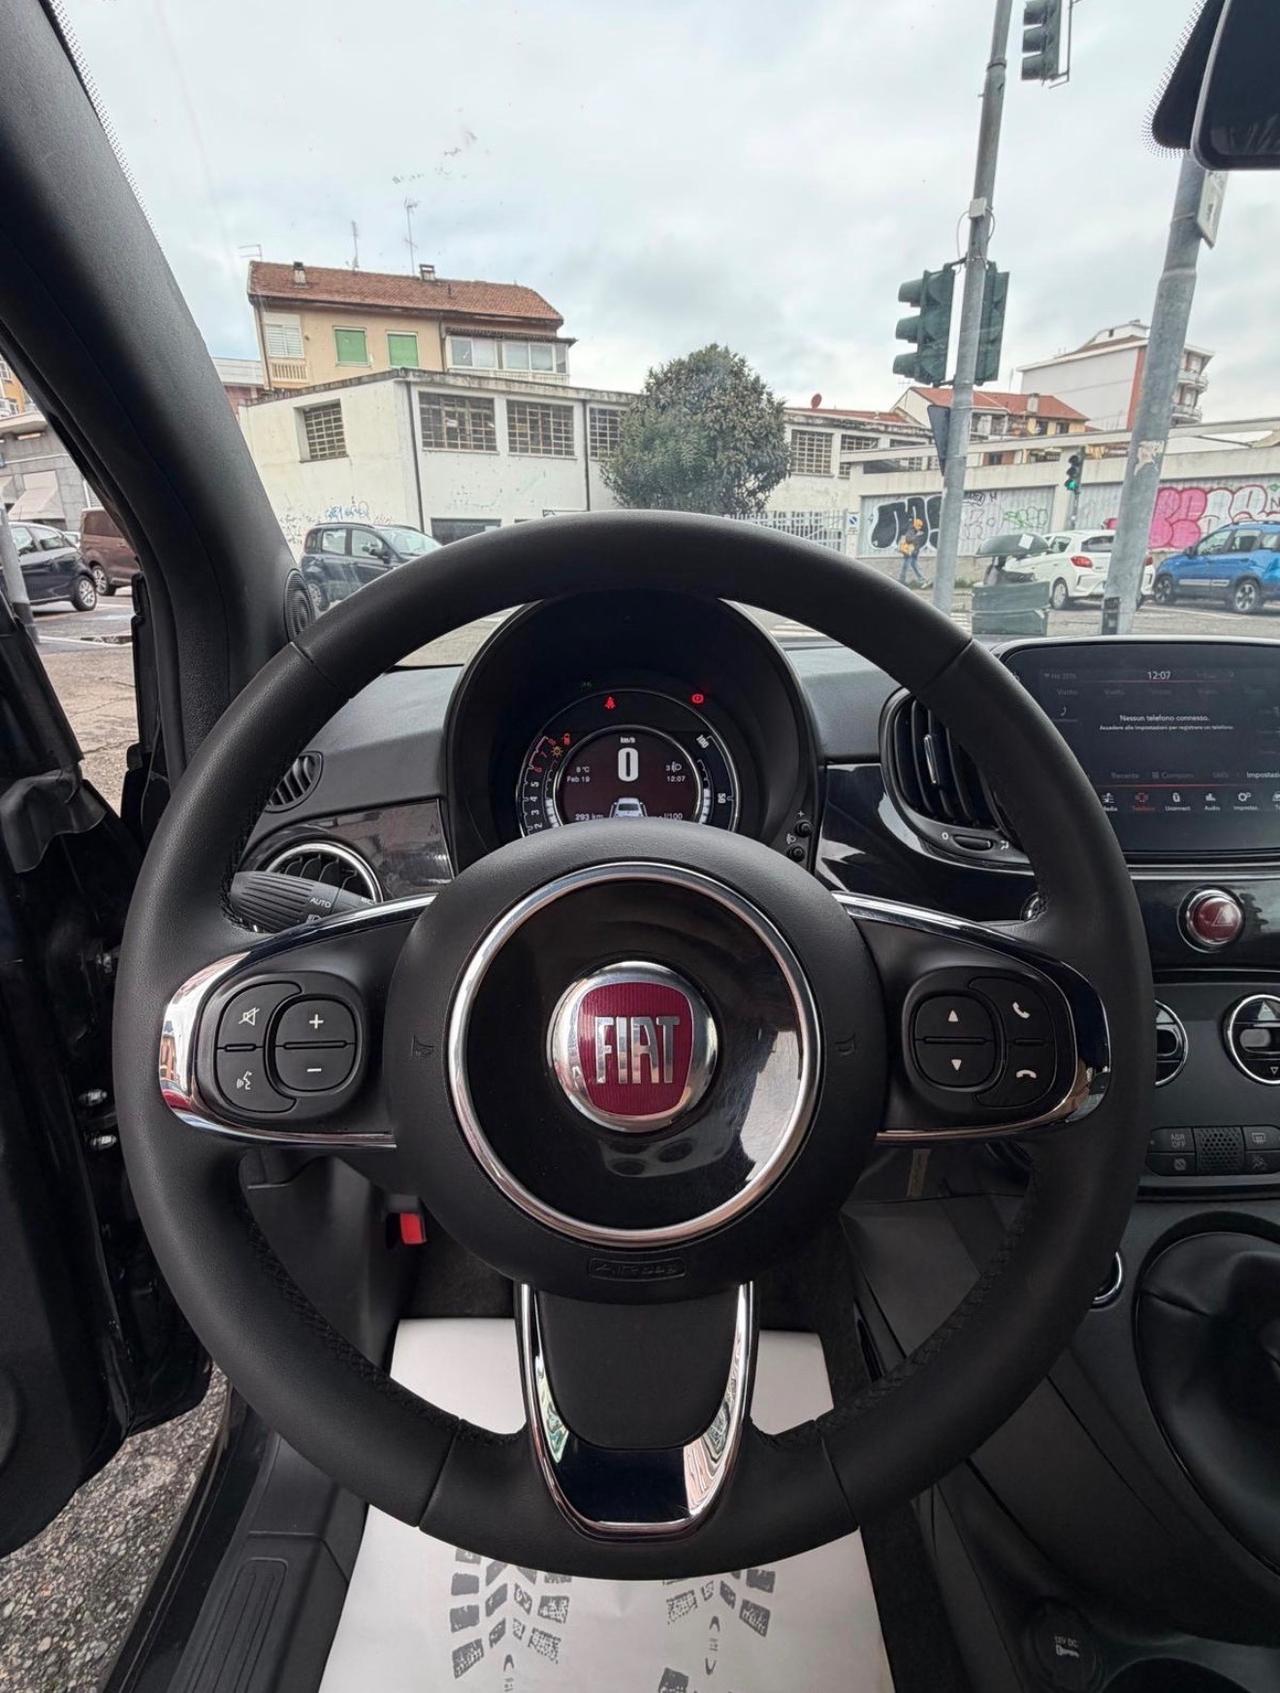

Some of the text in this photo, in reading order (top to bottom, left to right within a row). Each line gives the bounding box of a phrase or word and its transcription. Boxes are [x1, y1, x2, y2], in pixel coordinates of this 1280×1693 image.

[1147, 670, 1172, 681] 12:07
[1119, 714, 1145, 722] Nessun
[1146, 713, 1175, 722] telefono
[617, 747, 639, 782] 0
[566, 775, 580, 783] Feb
[309, 897, 332, 909] AUTO
[594, 1015, 681, 1084] FIAT
